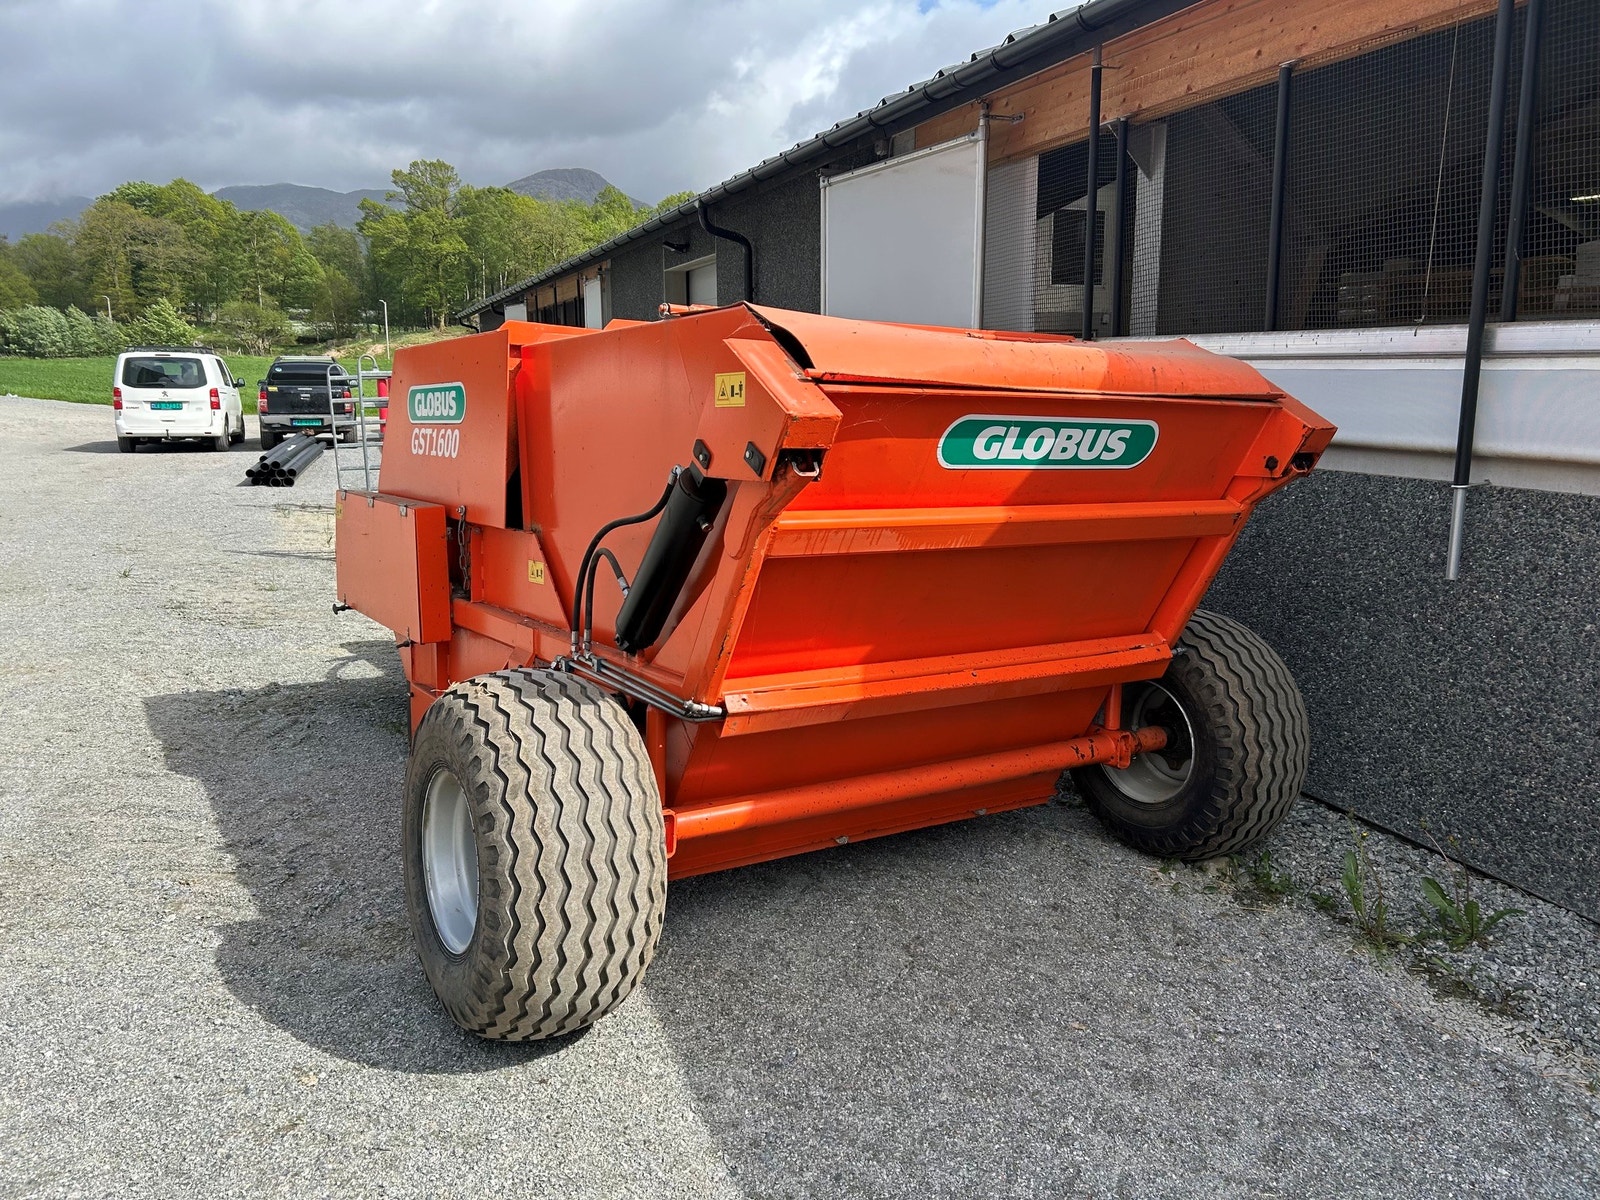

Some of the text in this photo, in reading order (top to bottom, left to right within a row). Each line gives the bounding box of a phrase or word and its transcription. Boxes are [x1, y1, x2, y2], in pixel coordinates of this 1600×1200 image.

[414, 390, 457, 417] GLOBUS
[411, 427, 460, 459] GST1600
[972, 425, 1132, 461] GLOBUS
